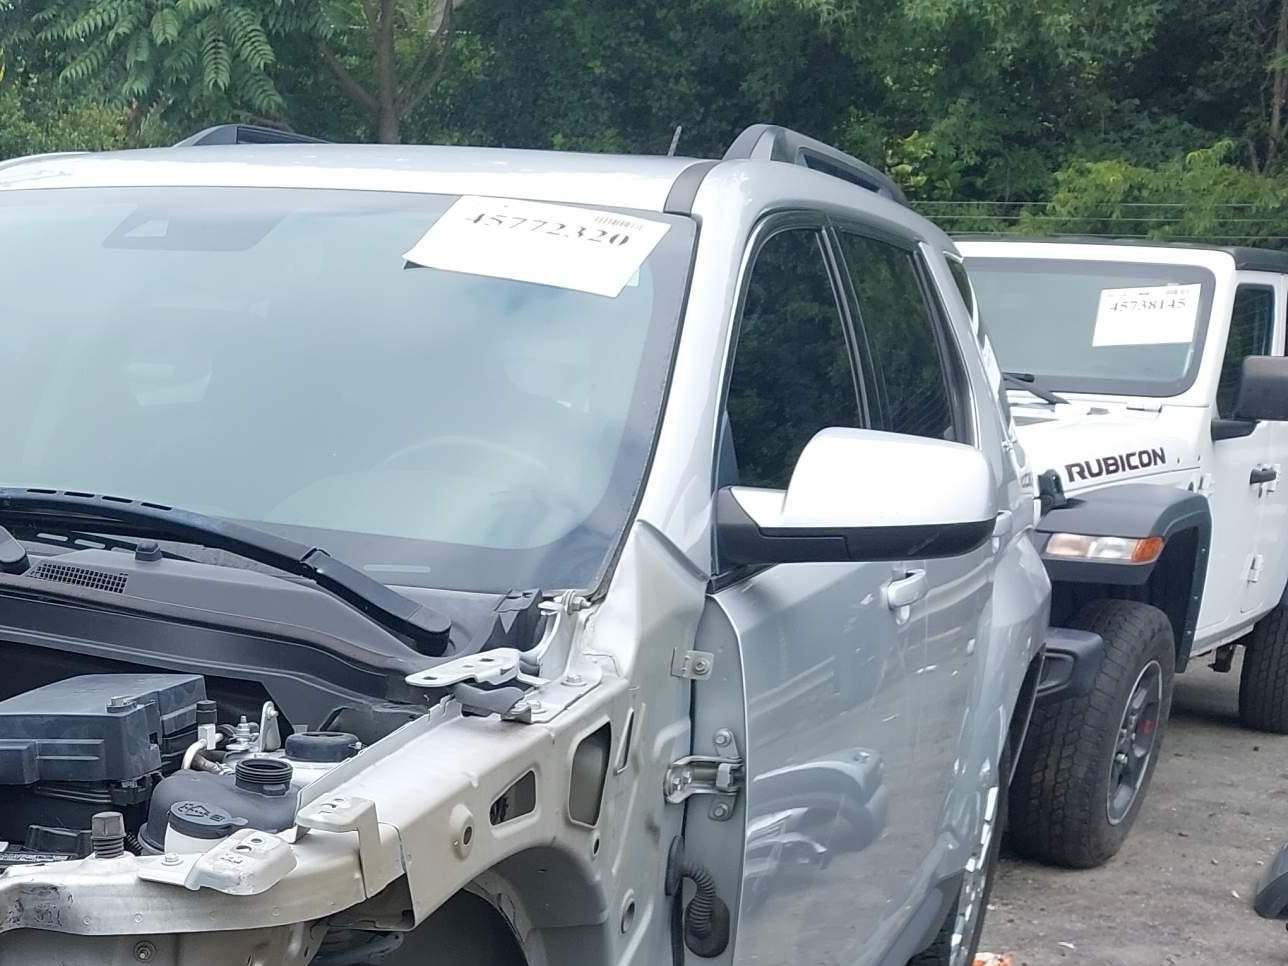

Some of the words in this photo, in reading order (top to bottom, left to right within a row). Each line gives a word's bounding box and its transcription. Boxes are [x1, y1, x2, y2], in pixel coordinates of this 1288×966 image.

[465, 211, 631, 247] 45772320
[1109, 298, 1186, 312] 45738145
[1065, 448, 1166, 483] RUBICON
